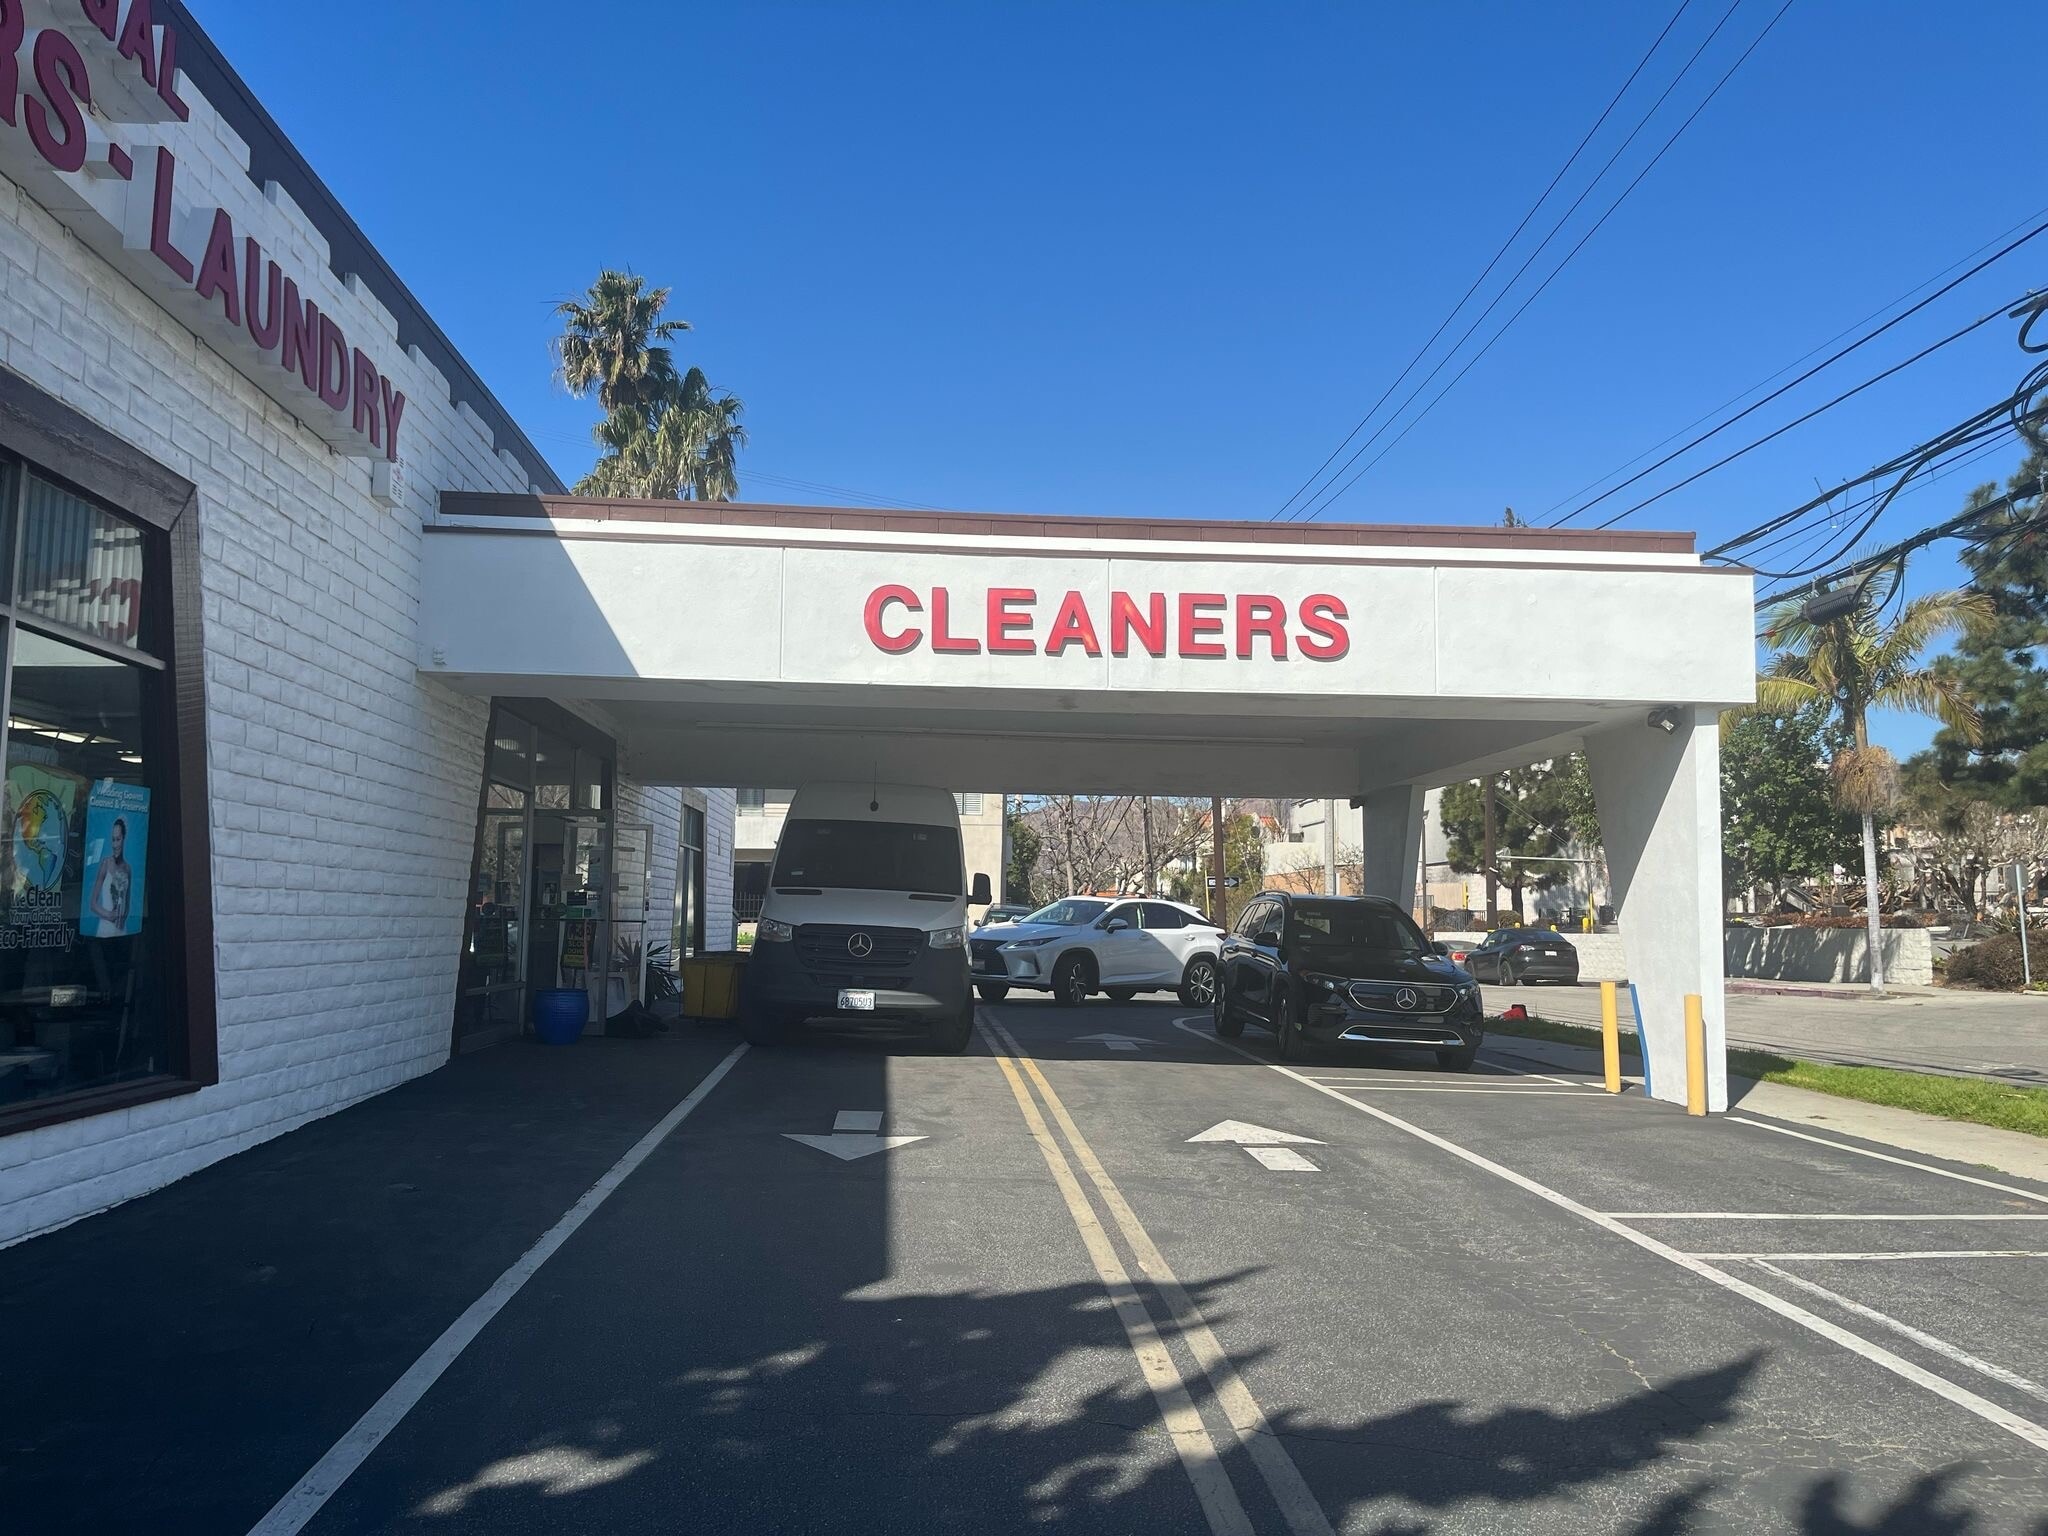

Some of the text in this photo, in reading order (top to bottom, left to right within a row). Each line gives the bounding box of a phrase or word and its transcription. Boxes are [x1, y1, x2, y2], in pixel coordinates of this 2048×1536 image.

[150, 145, 406, 463] LAUNDRY
[863, 583, 1350, 662] CLEANERS
[9, 908, 62, 925] Your Clothes
[26, 884, 62, 908] Clean
